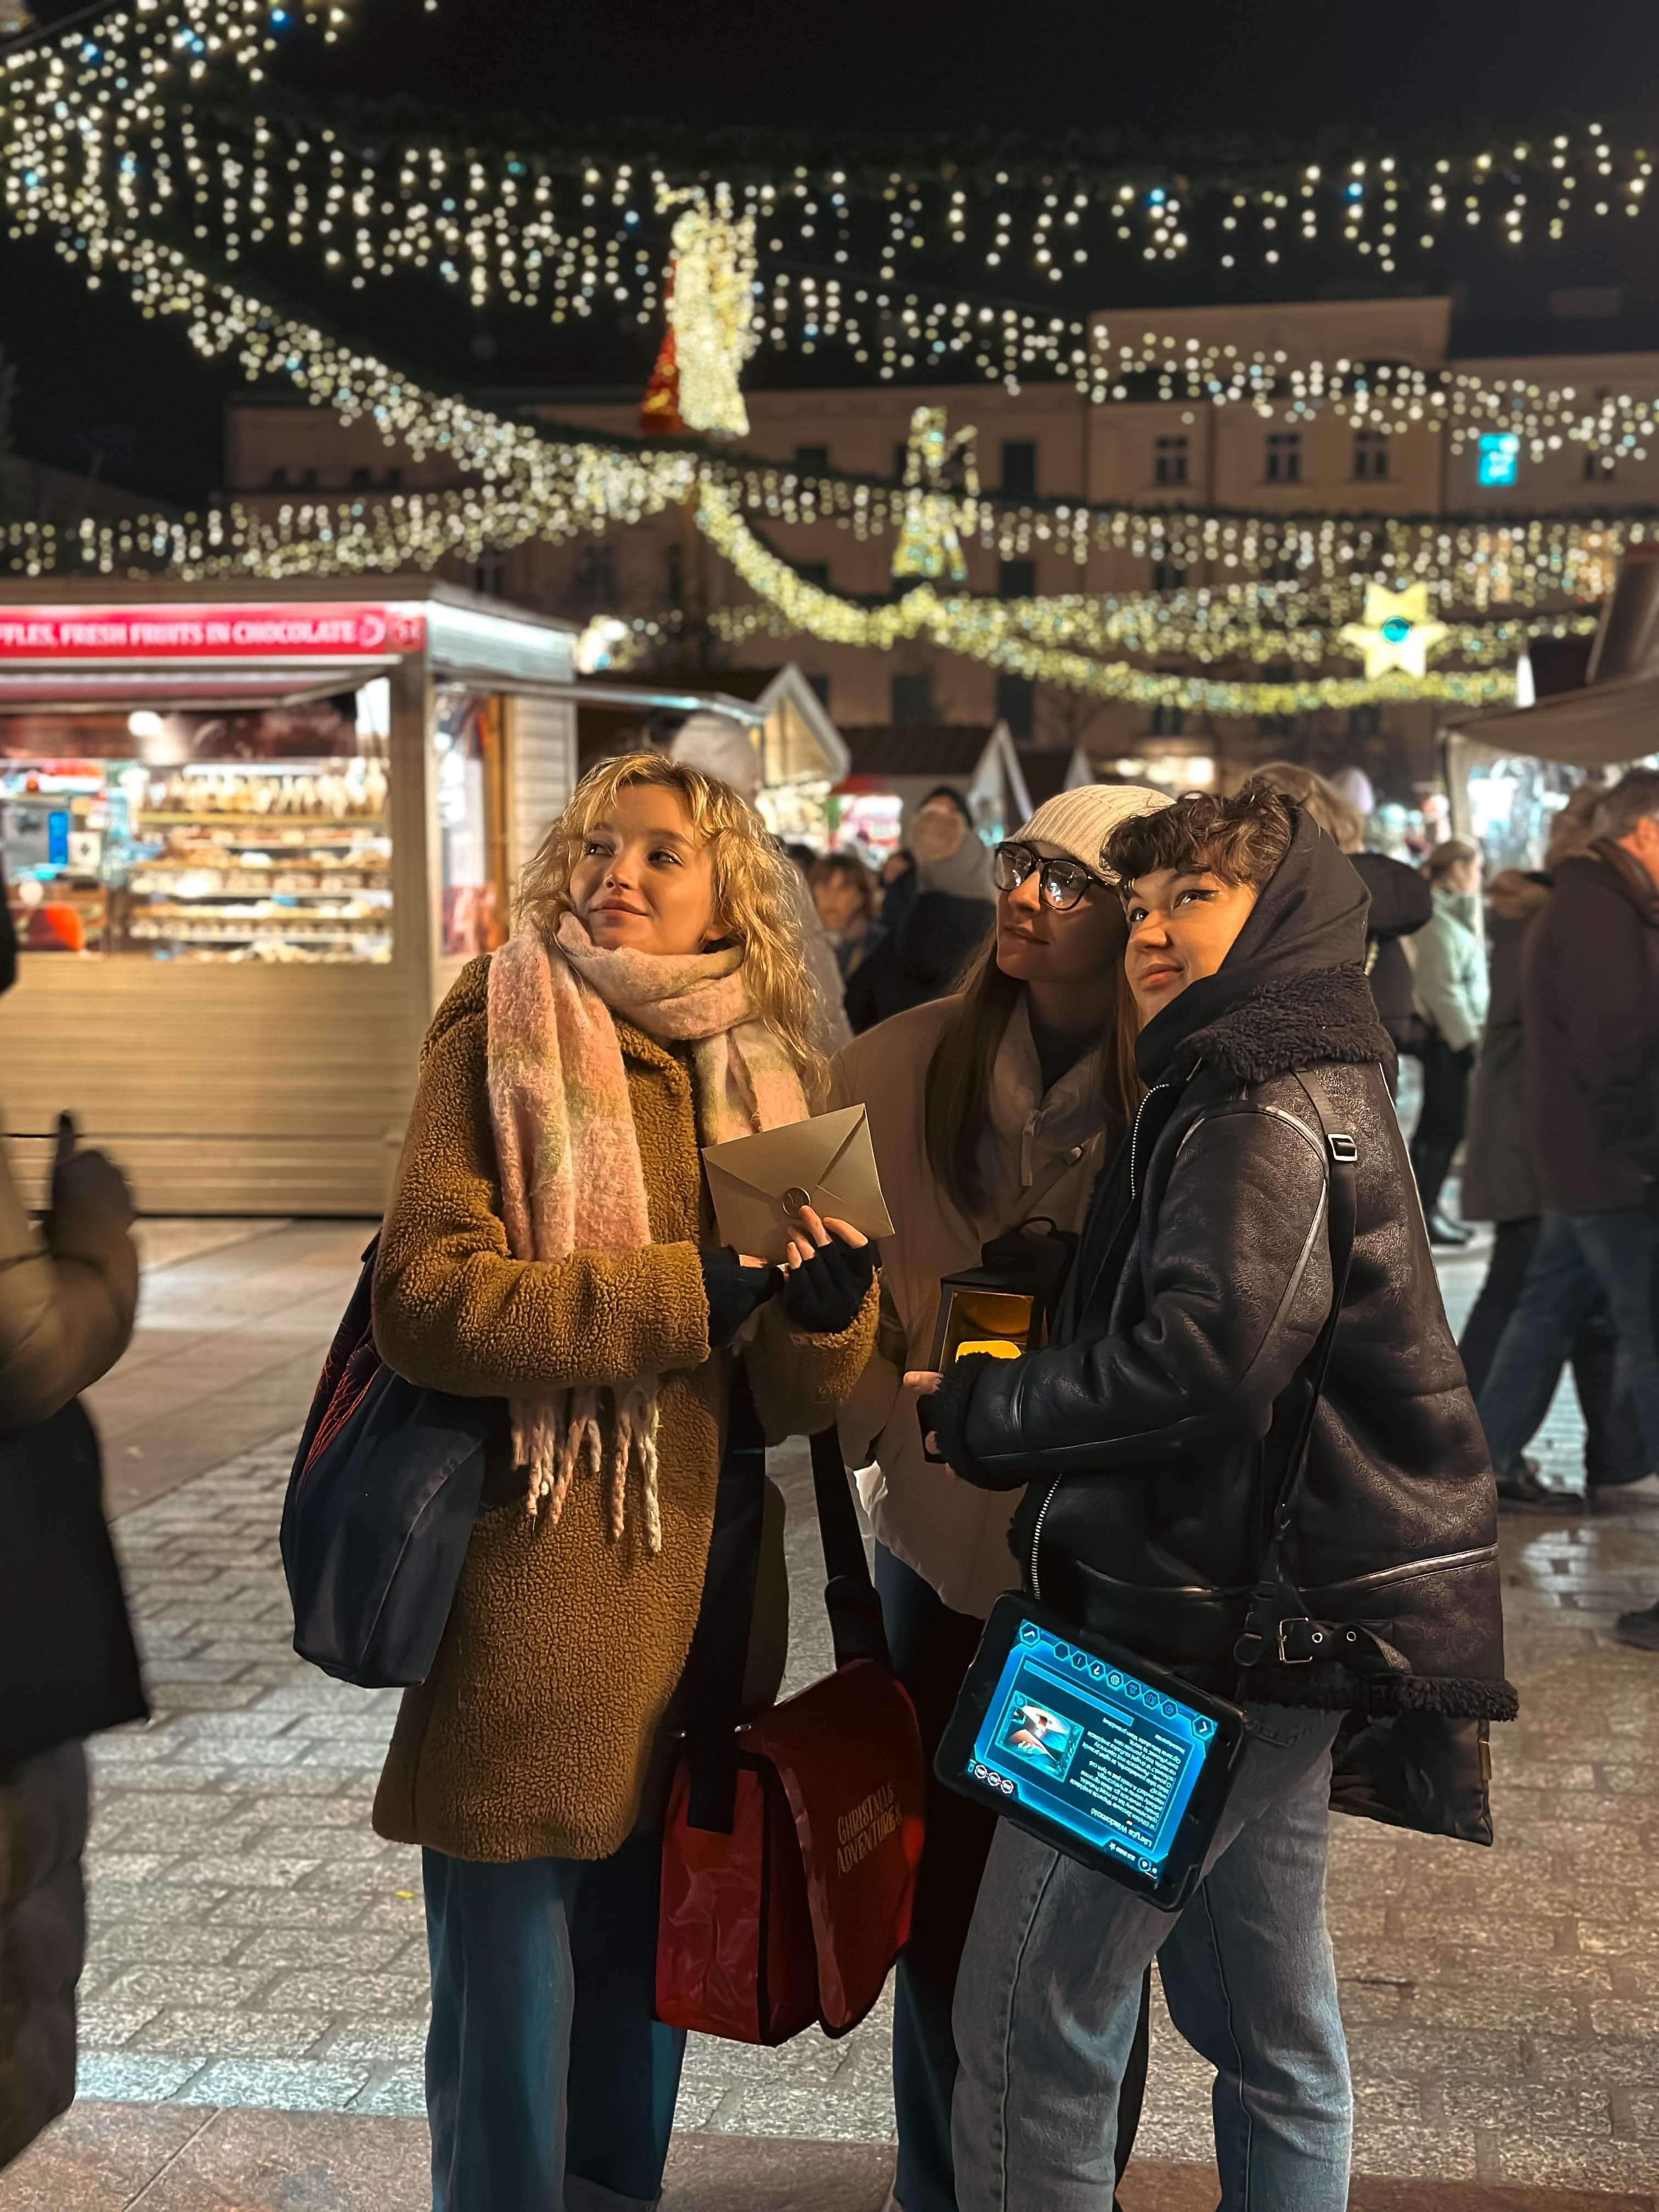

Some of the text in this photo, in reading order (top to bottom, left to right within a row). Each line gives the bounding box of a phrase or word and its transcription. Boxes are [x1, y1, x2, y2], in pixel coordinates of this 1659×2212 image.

[59, 623, 127, 646] FRESH
[129, 622, 204, 646] FRUITS
[206, 622, 230, 645] IN
[232, 619, 357, 645] CHOCOLATE
[837, 1781, 895, 1845] CHRISTMAS
[837, 1802, 902, 1878] ADVENTURES
